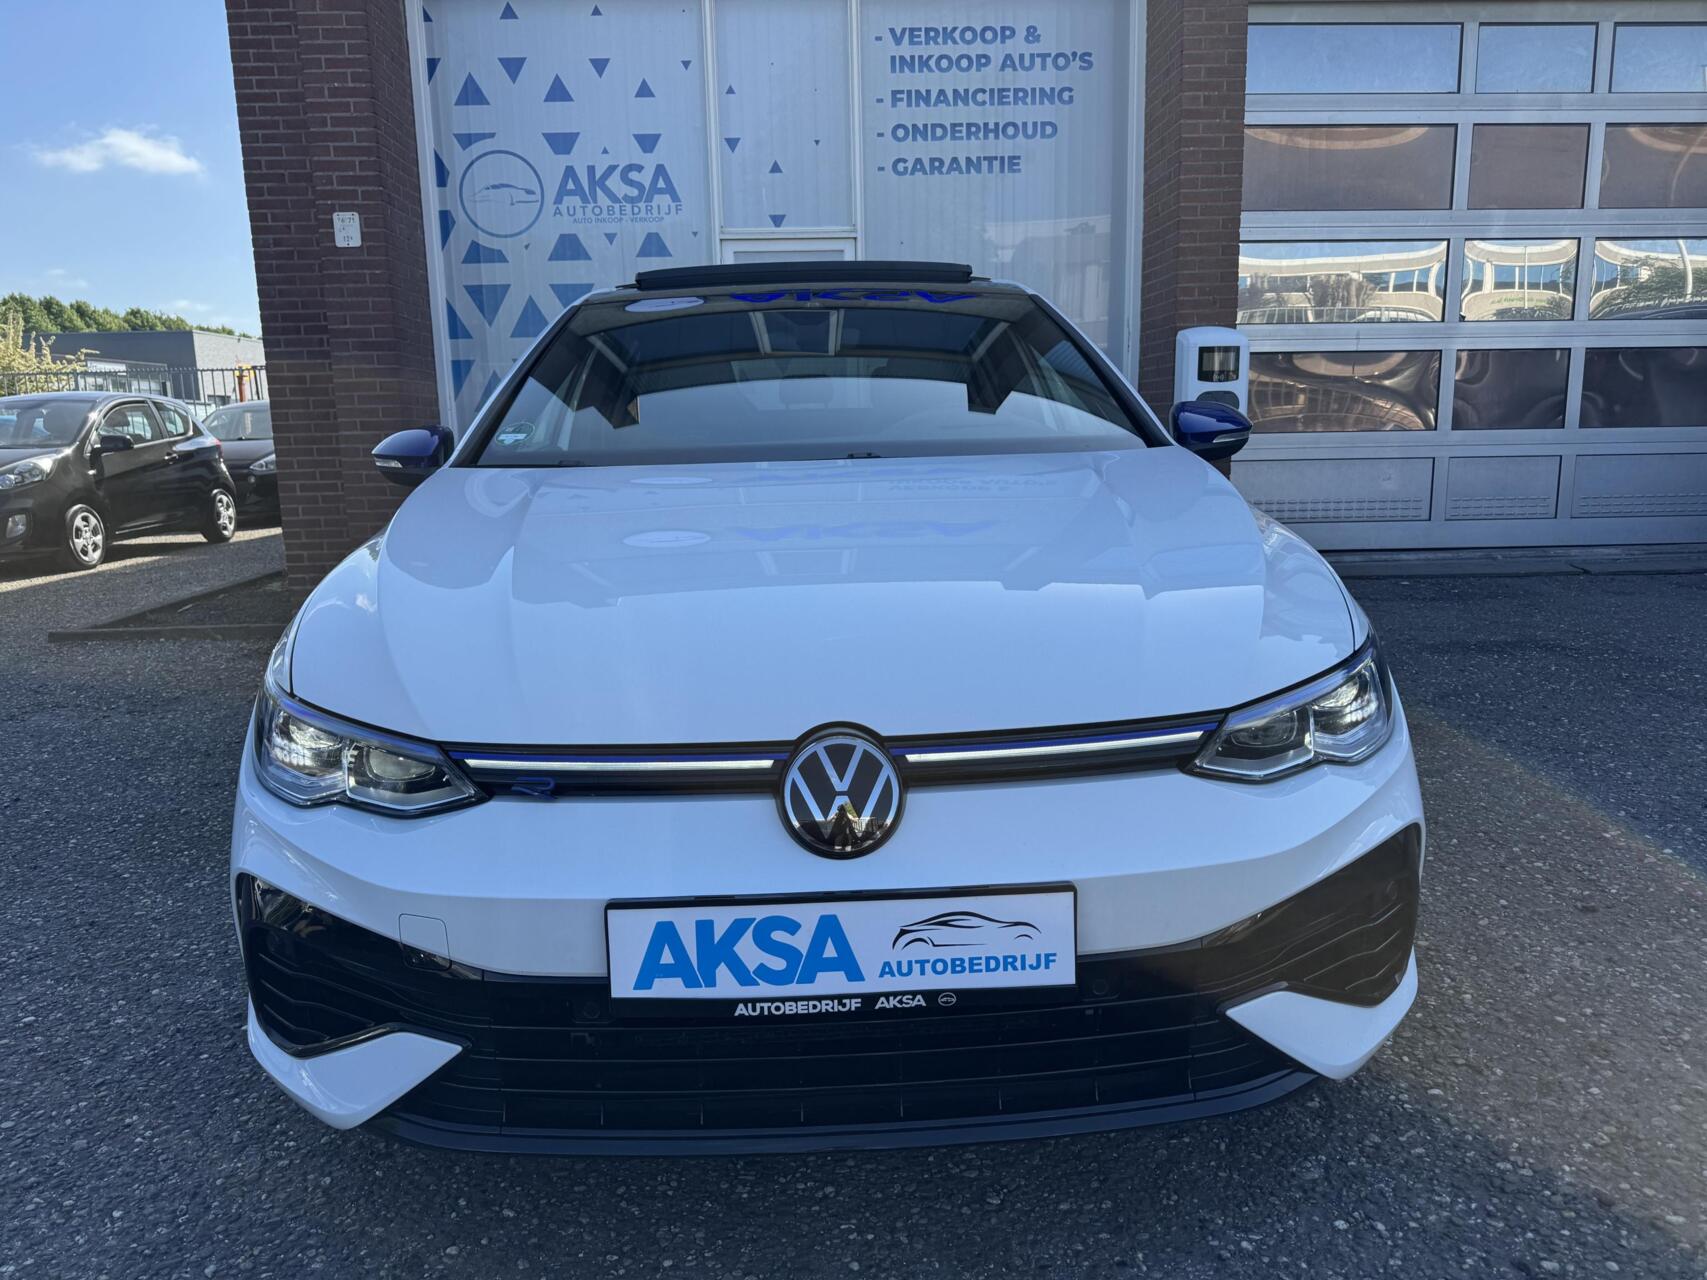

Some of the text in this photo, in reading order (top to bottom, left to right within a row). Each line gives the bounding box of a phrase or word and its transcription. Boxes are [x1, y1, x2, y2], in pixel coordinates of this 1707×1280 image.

[888, 25, 1016, 46] VERKOOP
[1024, 25, 1041, 44] &
[890, 51, 1094, 74] INKOOP AUTO’S
[891, 86, 1075, 108] FINANCIERING
[891, 121, 1058, 142] ONDERHOUD
[891, 155, 1022, 176] GARANTIE
[553, 163, 682, 205] AKSA
[553, 204, 683, 217] AUTOBEDRIJF
[573, 216, 593, 224] AUTO
[594, 216, 624, 224] INKOOP
[632, 914, 866, 990] AKSA
[878, 952, 1058, 978] AUTOBEDRIJF
[734, 994, 927, 1017] AUTOBEDRIJF AKSA
